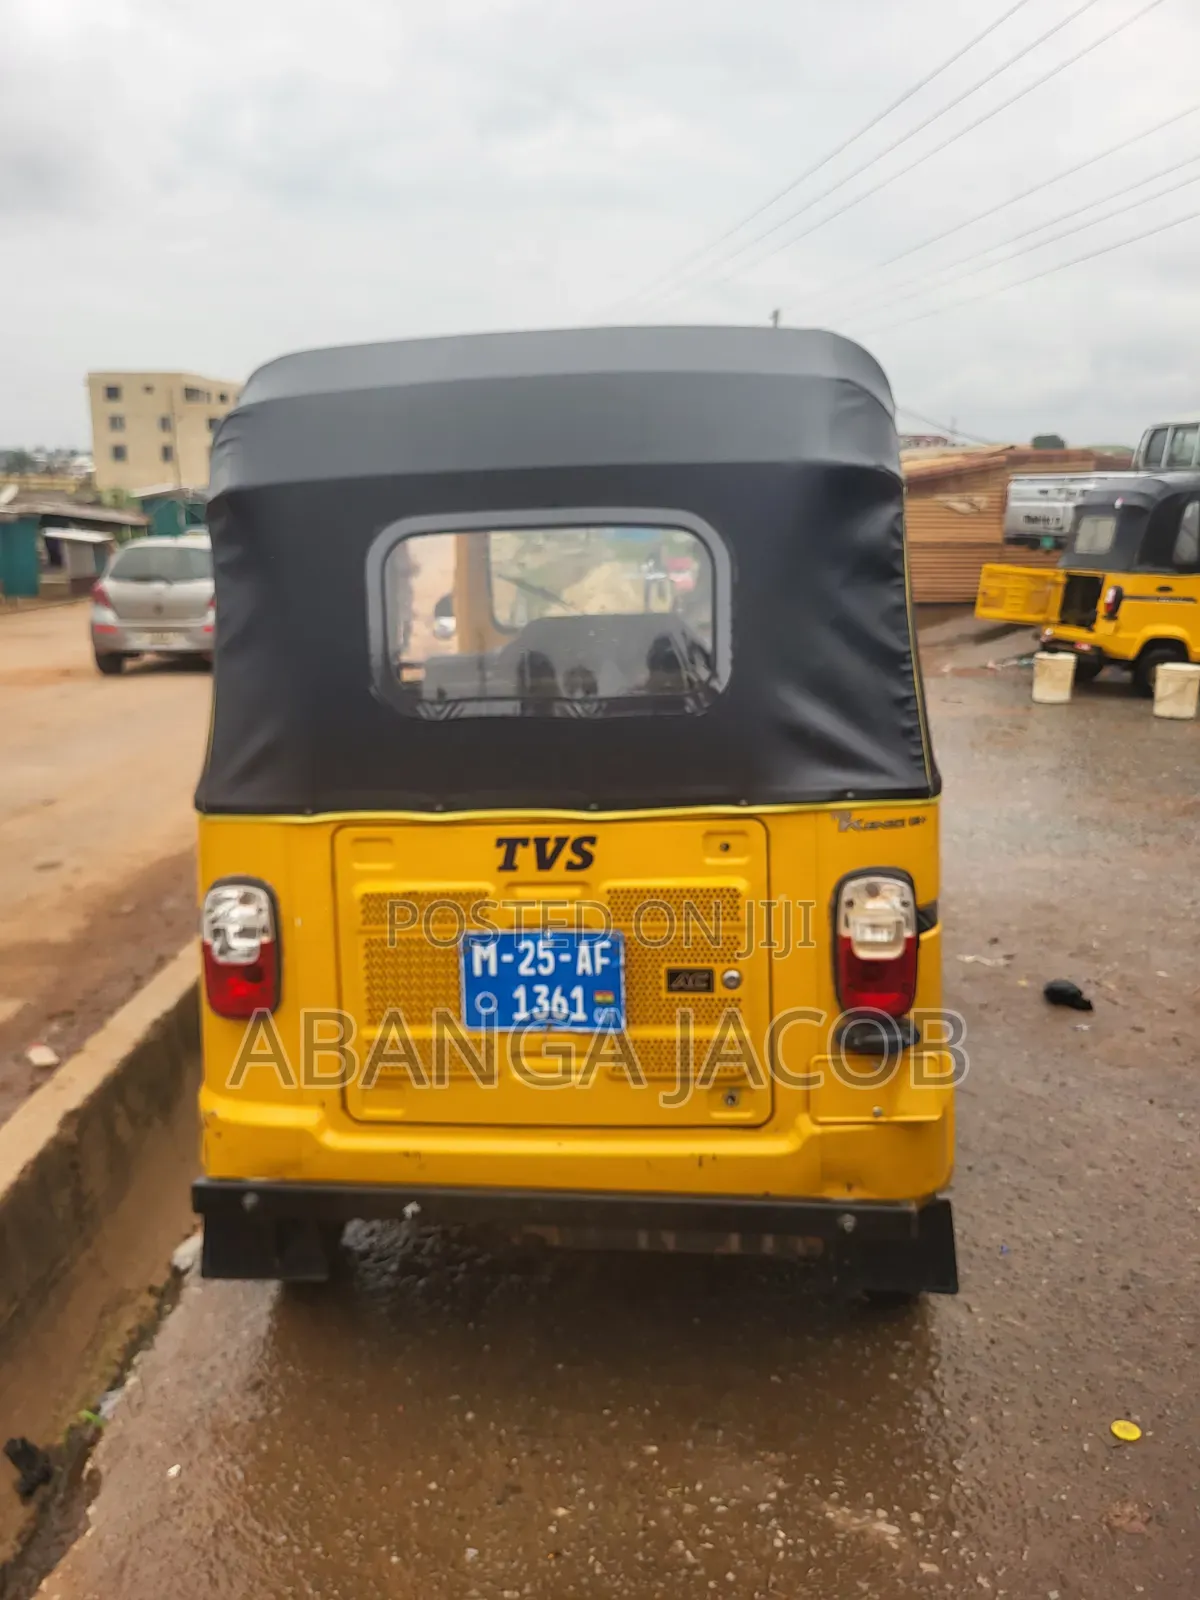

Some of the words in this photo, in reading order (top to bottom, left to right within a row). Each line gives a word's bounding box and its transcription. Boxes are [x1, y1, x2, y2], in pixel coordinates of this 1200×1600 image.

[495, 835, 597, 872] TVS
[471, 940, 611, 977] M-25-AF
[512, 984, 588, 1022] 1361
